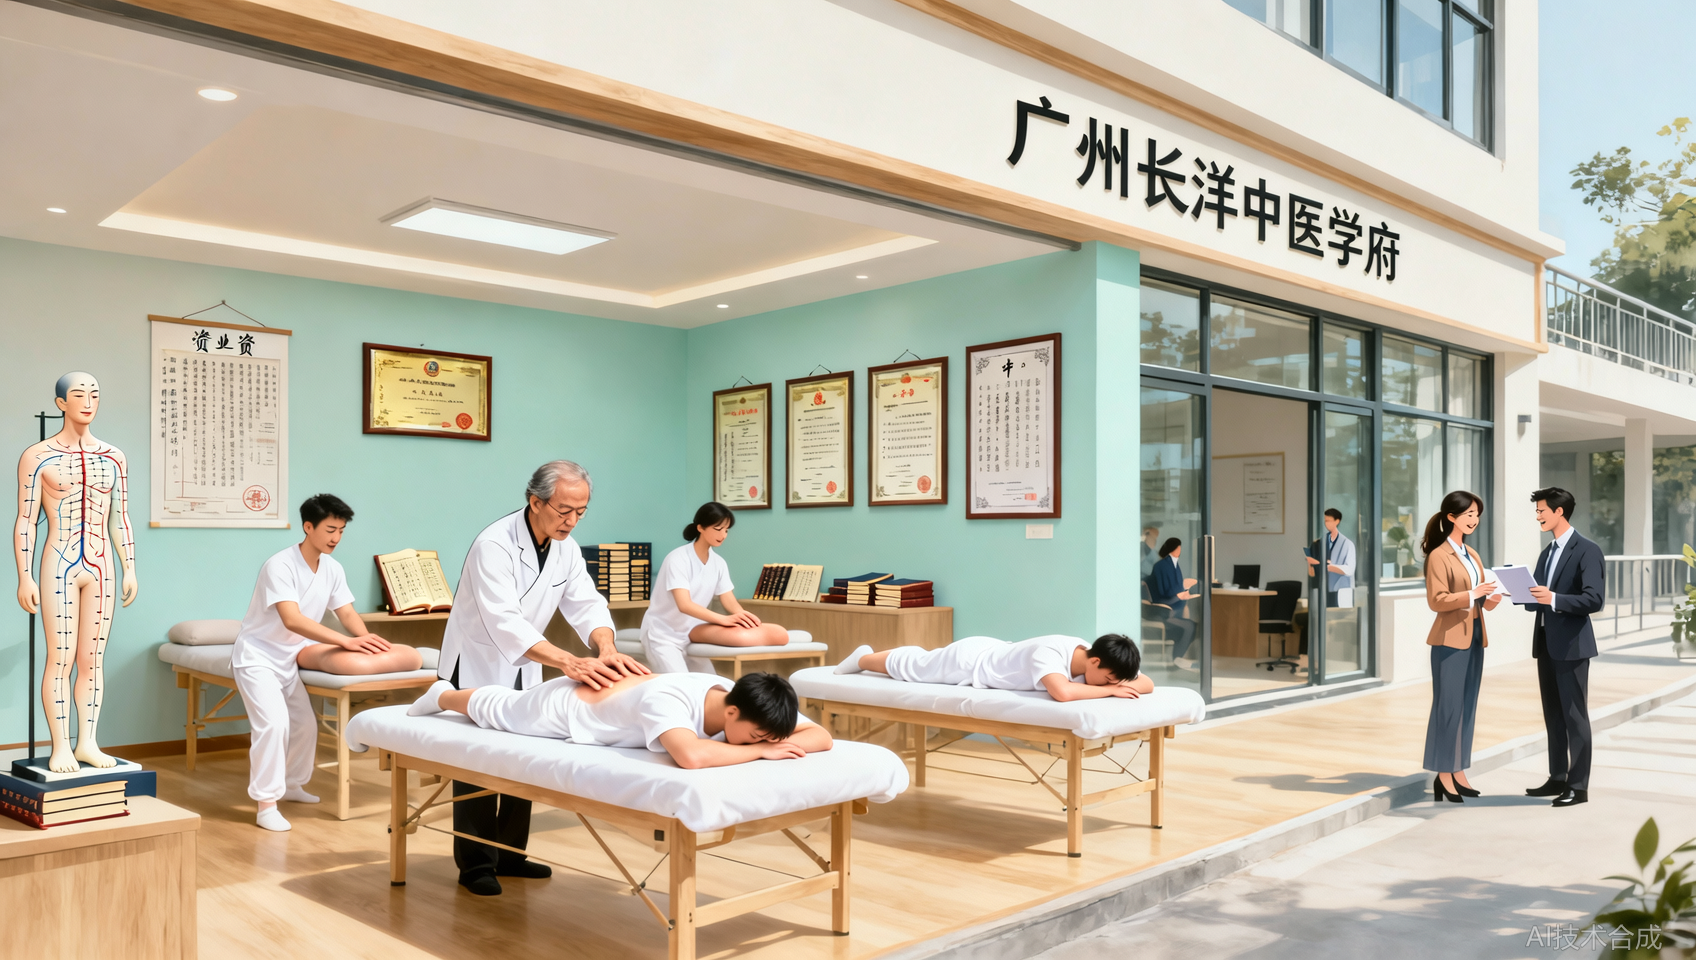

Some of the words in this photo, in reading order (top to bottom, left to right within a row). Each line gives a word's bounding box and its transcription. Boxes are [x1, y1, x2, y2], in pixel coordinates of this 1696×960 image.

[1007, 96, 1400, 281] 广州长洋中医学府
